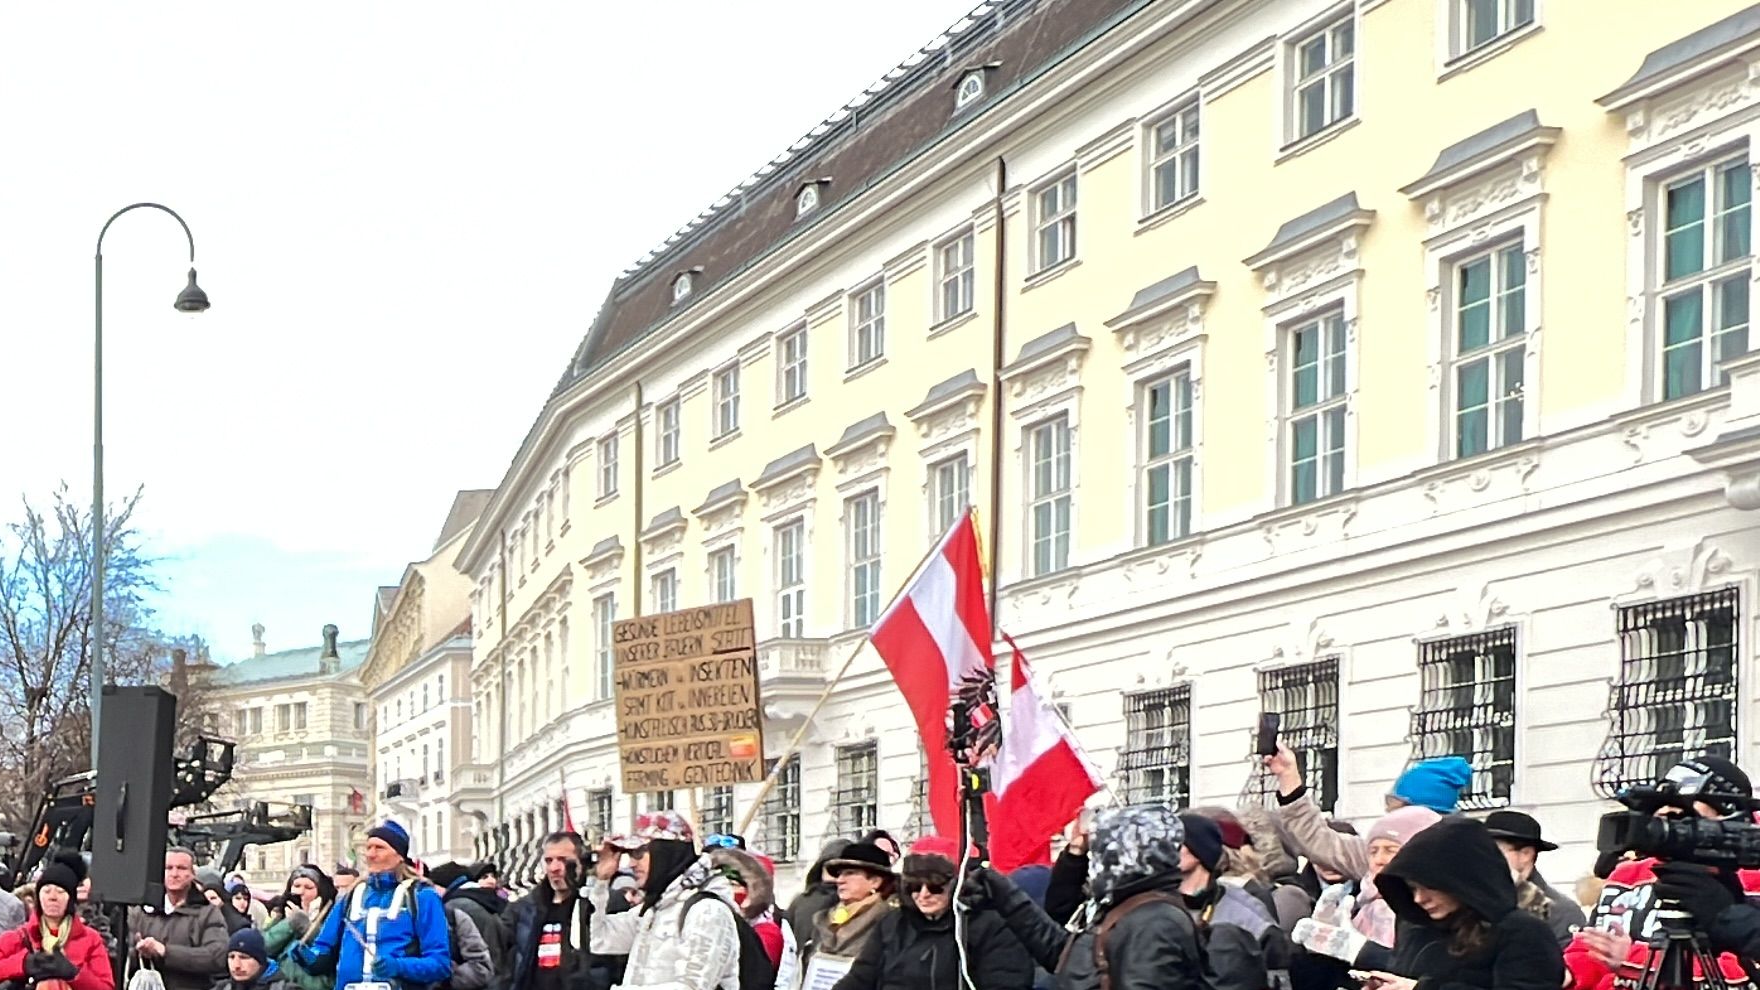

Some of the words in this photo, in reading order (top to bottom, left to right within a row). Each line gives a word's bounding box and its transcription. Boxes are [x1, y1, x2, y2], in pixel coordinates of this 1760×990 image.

[615, 620, 659, 643] GESUNDE
[664, 605, 741, 635] LEBENSMITTEL
[616, 642, 660, 664] UNSERER
[711, 628, 752, 651] STATT
[689, 656, 753, 682] INSEKTEN
[624, 694, 652, 716] SAMT
[683, 760, 757, 784] GENTECHNIK
